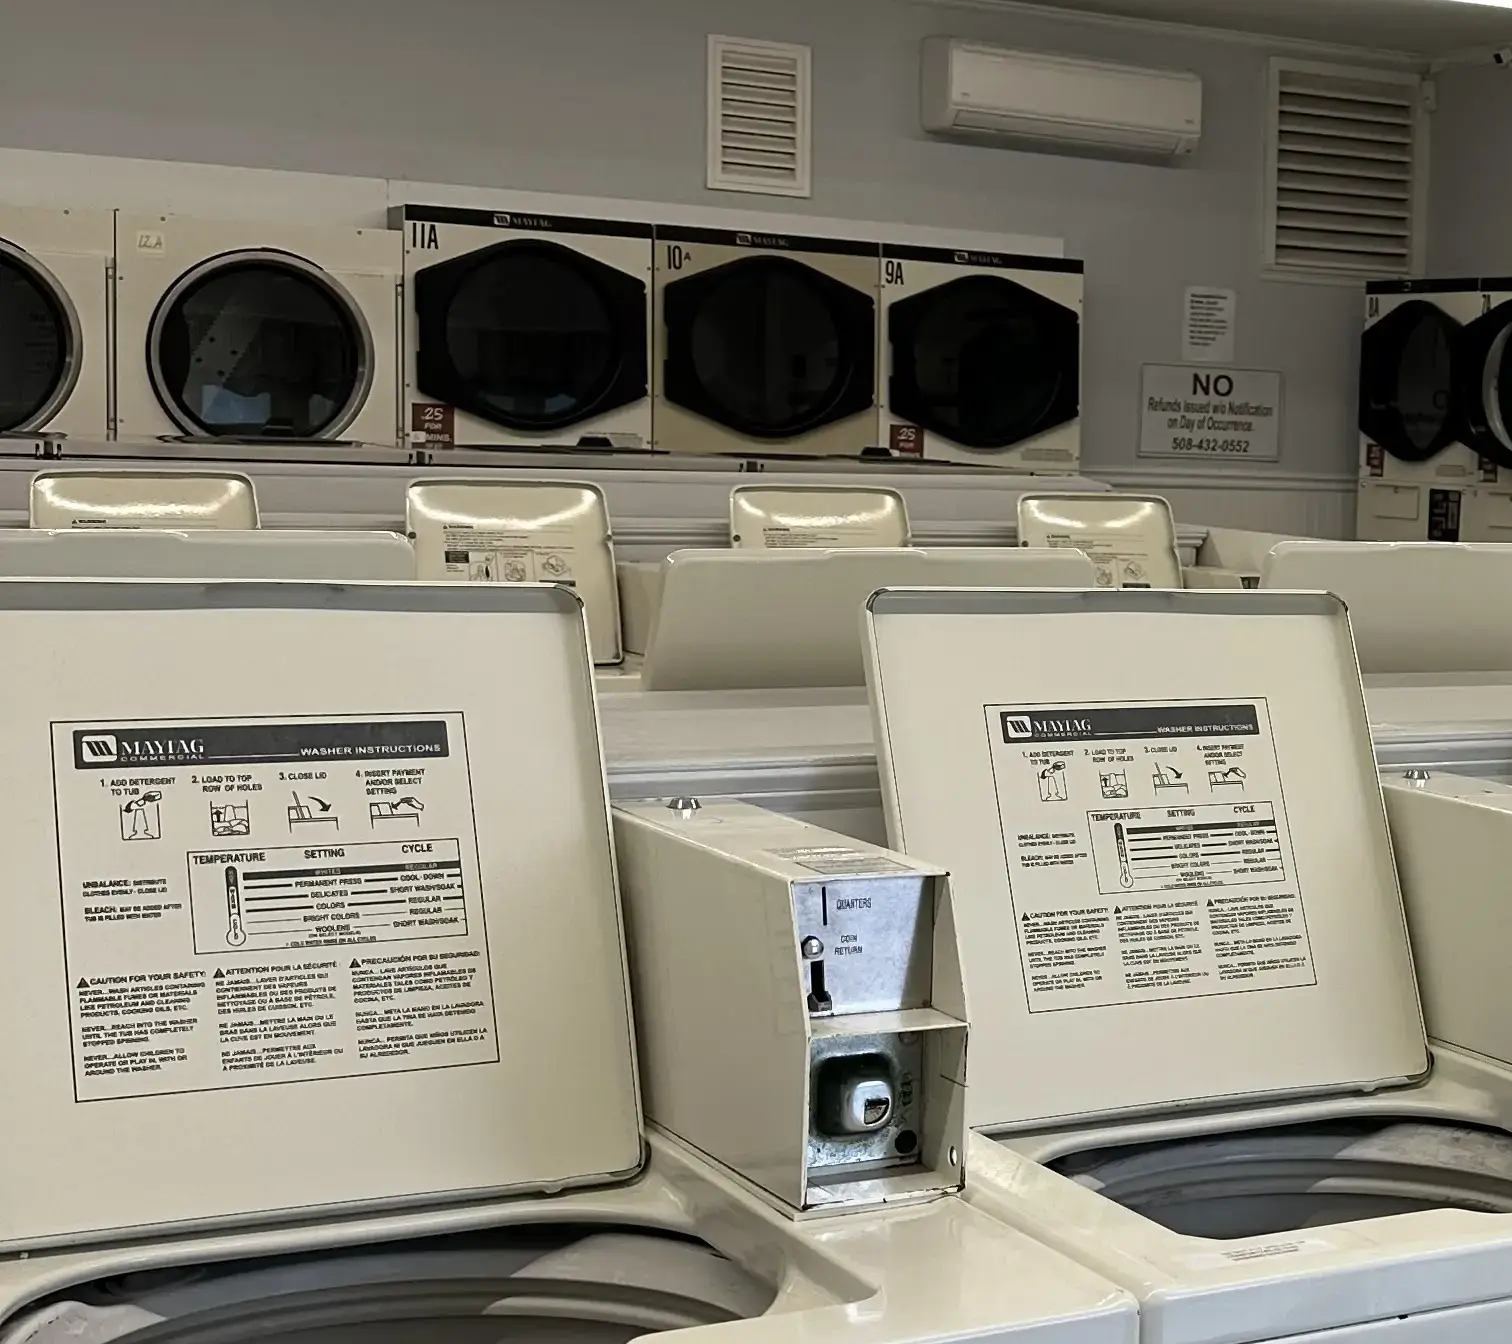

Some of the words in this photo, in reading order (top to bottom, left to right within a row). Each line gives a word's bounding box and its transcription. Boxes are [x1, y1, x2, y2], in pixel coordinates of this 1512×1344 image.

[412, 222, 439, 250] 11A
[885, 260, 905, 285] 9A
[1192, 372, 1234, 397] NO
[1147, 396, 1182, 413] Refunds
[1228, 402, 1273, 417] Notification
[1167, 417, 1179, 429] on
[1179, 415, 1196, 433] Day
[1197, 416, 1207, 430] of
[1171, 436, 1250, 453] 508-432-0552
[1033, 719, 1092, 732] MAYTAG
[1157, 725, 1193, 733] WASHER
[1194, 723, 1254, 732] INSTRUCTIONS
[120, 738, 204, 756] MAYTAG
[120, 753, 205, 762] COMMERCIAL
[300, 746, 353, 756] WASHER
[355, 744, 442, 755] INSTRUCTIONS
[128, 777, 176, 786] DETERGENT
[201, 775, 223, 784] LOAD
[224, 775, 236, 783] TO
[287, 772, 313, 781] CLOSE
[123, 788, 140, 796] TUB
[237, 783, 263, 792] HOLES
[1091, 811, 1142, 822] TEMPERATURE
[1233, 805, 1256, 814] CYCLE
[193, 852, 266, 865] TEMPERATURE
[303, 848, 346, 860] SETTING
[401, 843, 434, 854] CYCLE
[836, 897, 872, 911] QUARTERS
[225, 967, 270, 976] ATTENTION
[270, 964, 292, 972] POUR
[89, 976, 128, 986] CAUTION
[128, 975, 147, 983] FOR
[147, 973, 172, 981] YOUR
